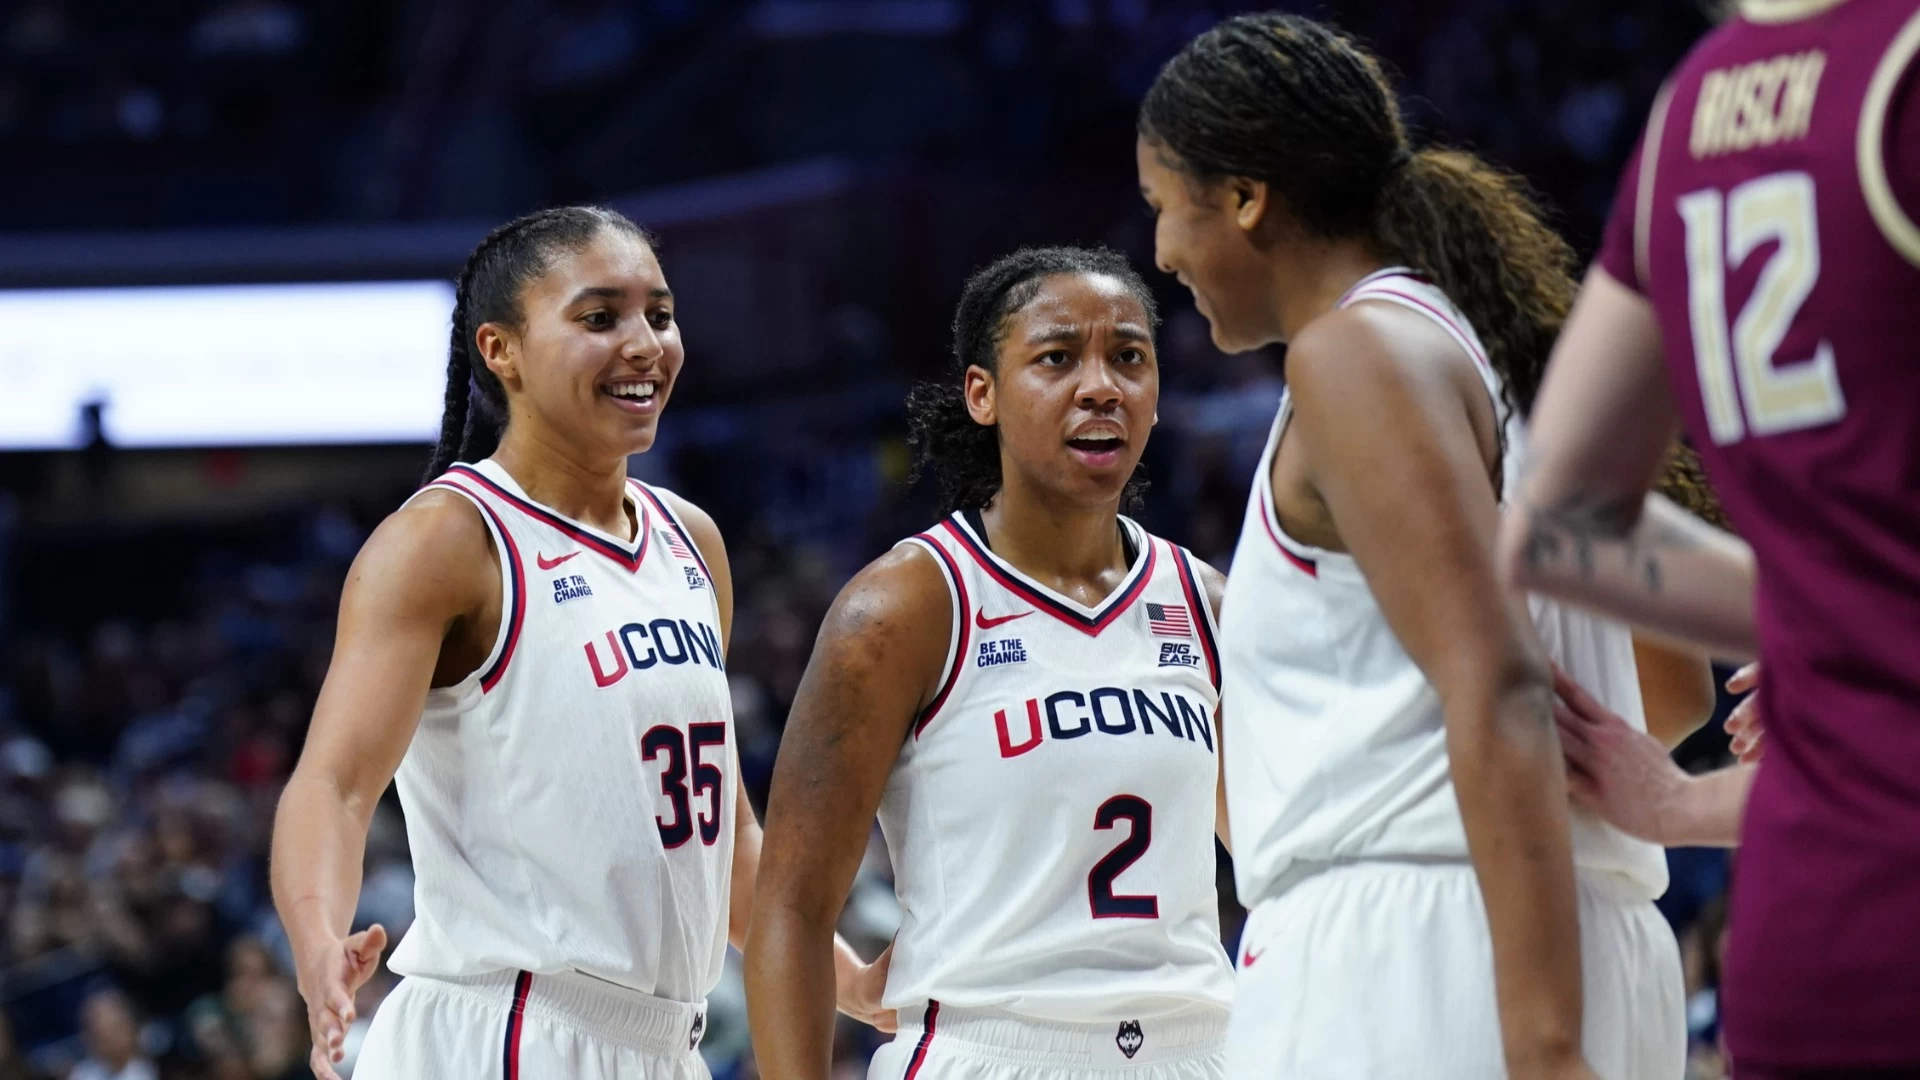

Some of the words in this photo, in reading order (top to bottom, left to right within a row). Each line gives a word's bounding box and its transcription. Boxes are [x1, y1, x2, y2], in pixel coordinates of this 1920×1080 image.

[1677, 171, 1847, 446] 12
[684, 566, 698, 576] BIG
[553, 577, 569, 591] BE
[687, 576, 705, 586] EAST
[554, 585, 593, 603] CHANGE
[980, 641, 996, 654] BE
[1000, 638, 1023, 651] THE
[1161, 643, 1191, 654] BIG
[977, 650, 1027, 668] CHANGE
[1159, 653, 1200, 666] EAST
[994, 687, 1214, 758] UCONN
[641, 722, 726, 849] 35
[1088, 794, 1159, 919] 2
